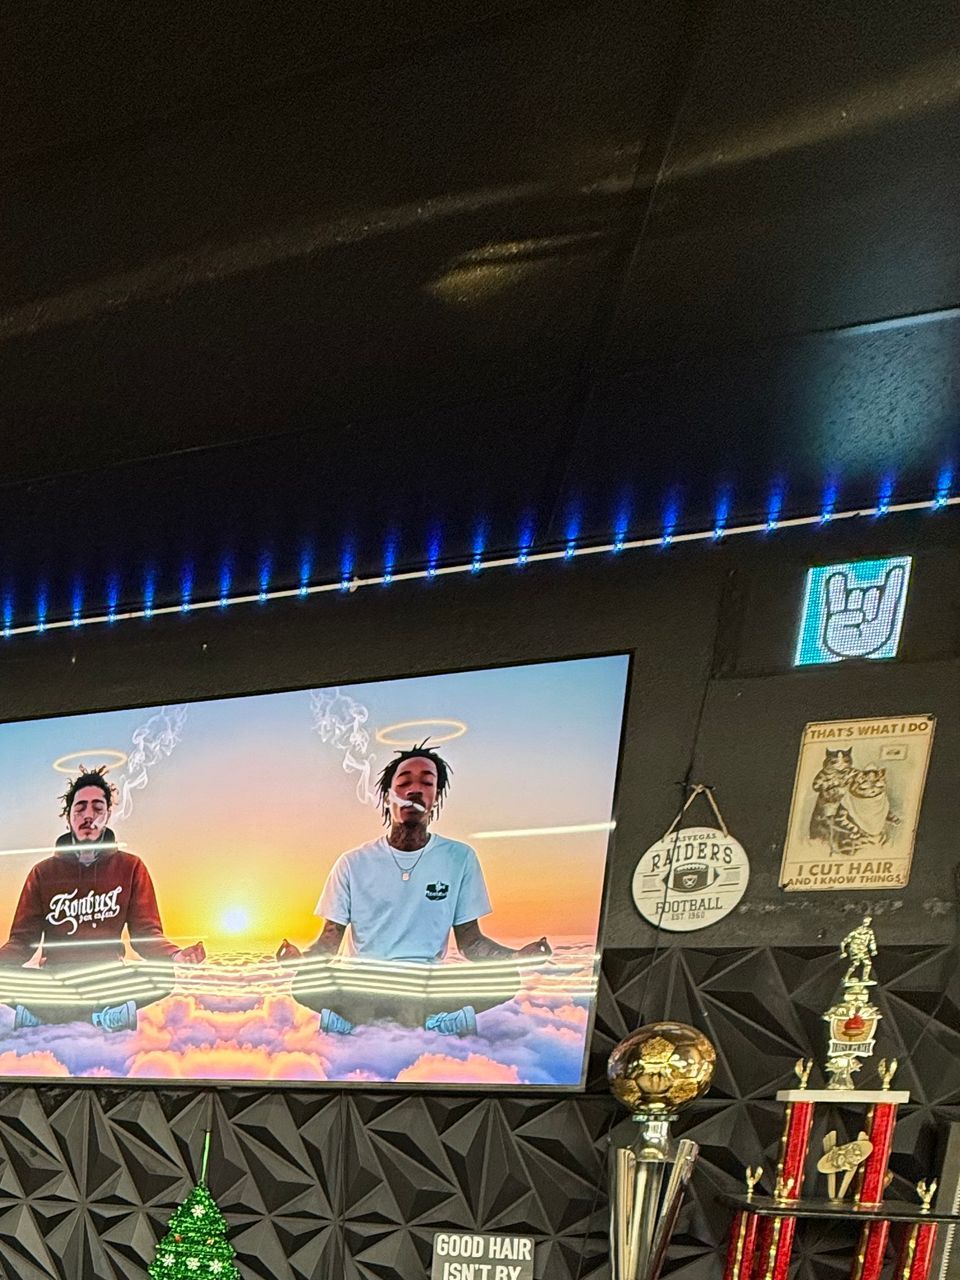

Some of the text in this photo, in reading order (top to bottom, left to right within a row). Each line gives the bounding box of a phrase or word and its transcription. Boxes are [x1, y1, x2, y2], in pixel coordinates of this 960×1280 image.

[810, 721, 929, 740] THAT'S WHAT I DO
[651, 842, 733, 873] RAIDERS
[797, 861, 894, 877] I CUT HAIR
[787, 877, 811, 887] AND
[819, 875, 857, 885] KNOW
[655, 896, 724, 915] FOOTBALL
[436, 1234, 532, 1261] GOOD HAIR
